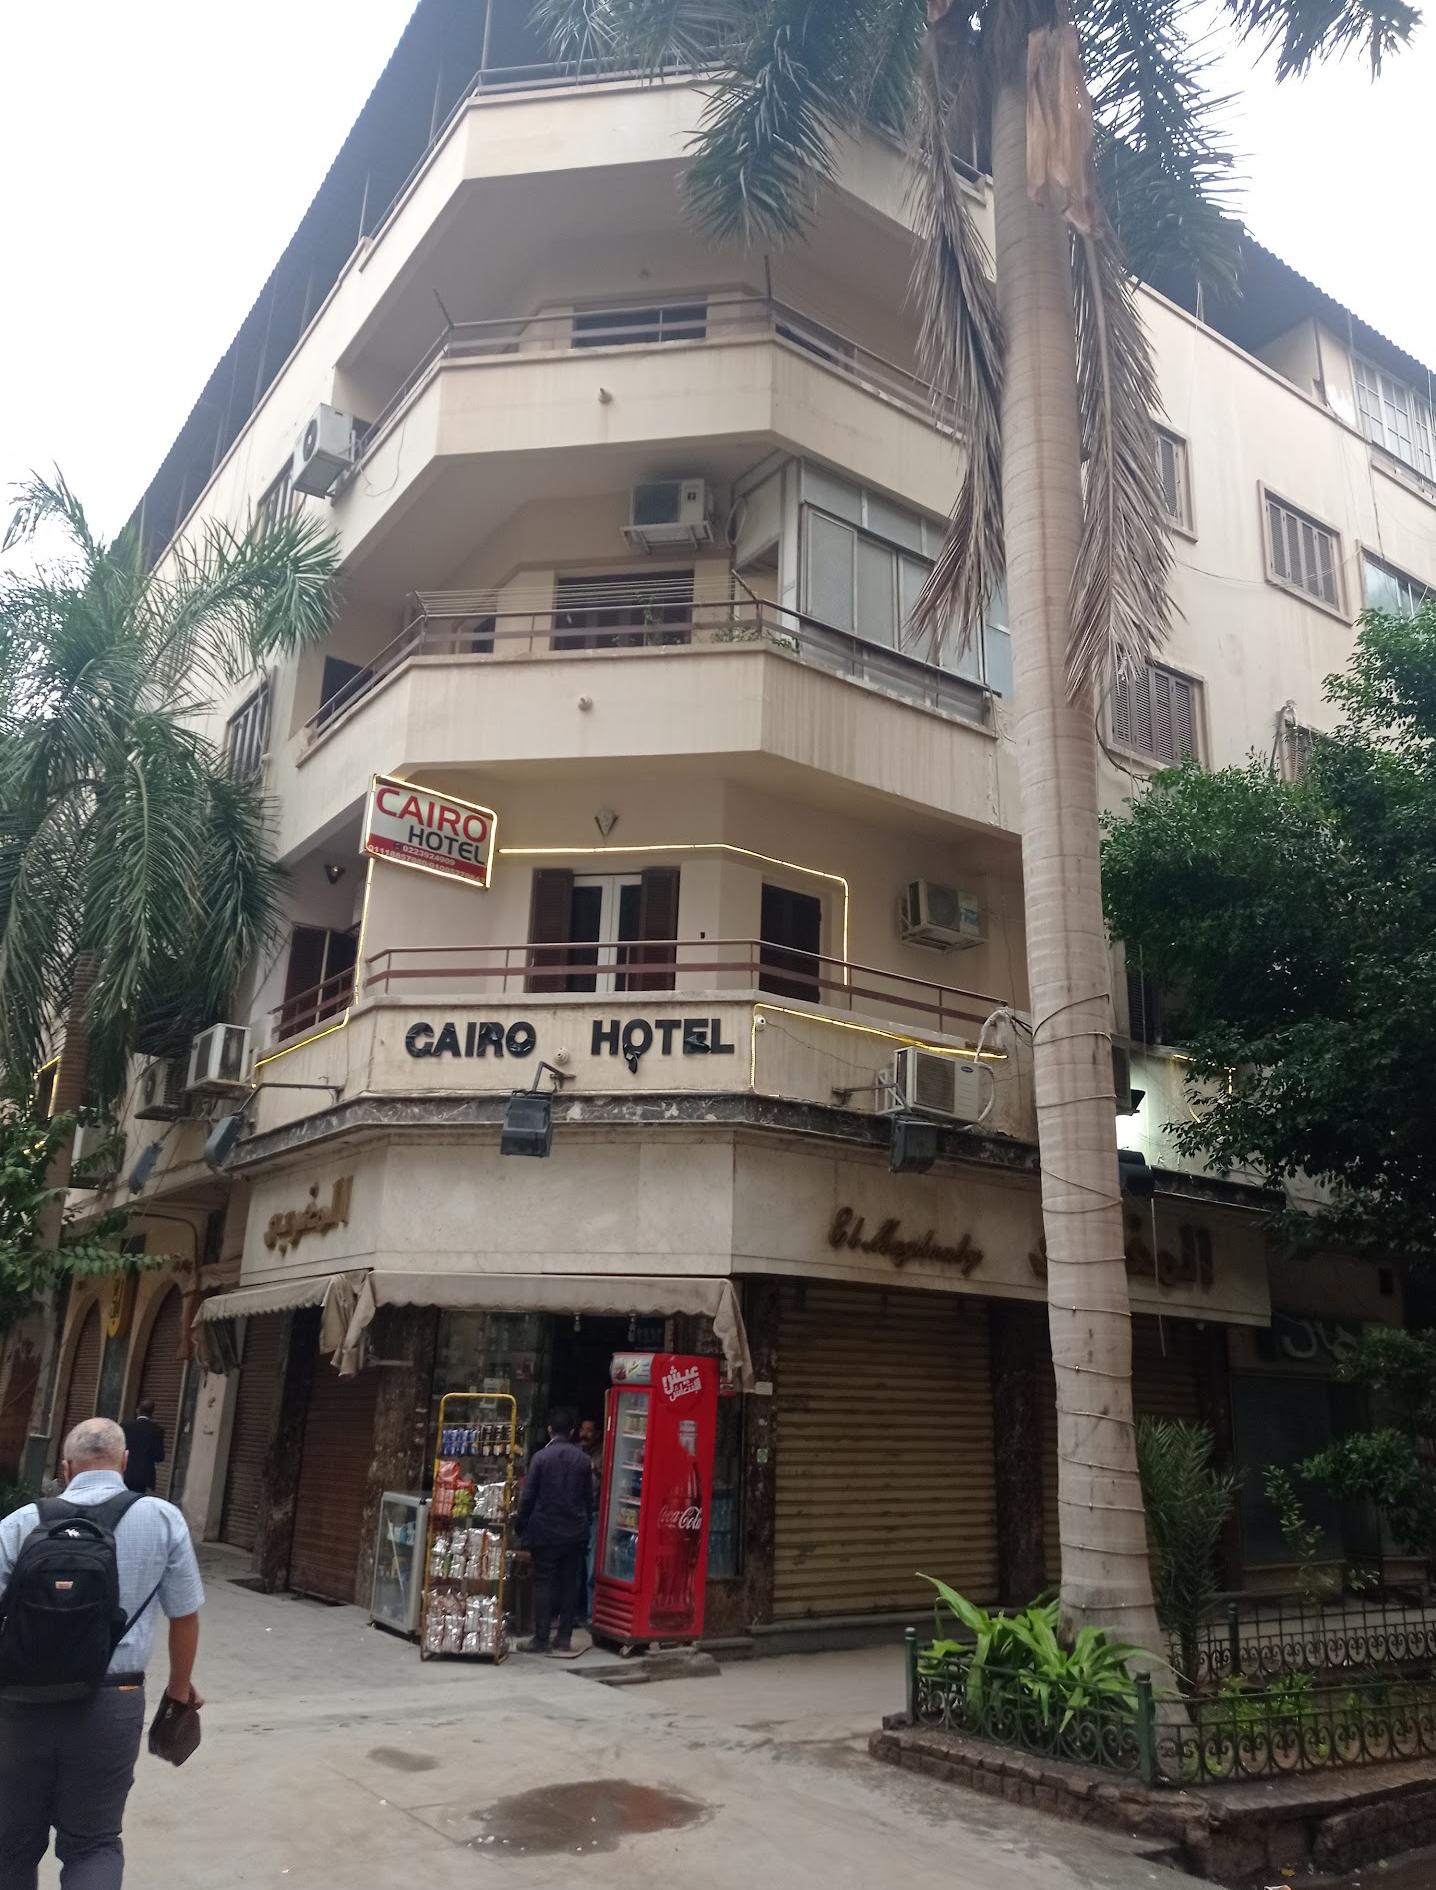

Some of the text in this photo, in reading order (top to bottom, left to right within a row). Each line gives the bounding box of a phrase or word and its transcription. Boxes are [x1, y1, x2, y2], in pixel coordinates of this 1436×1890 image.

[376, 787, 488, 843] CAIRO
[408, 825, 486, 865] HOTEL
[405, 1018, 735, 1060] CAIRO HOTEL
